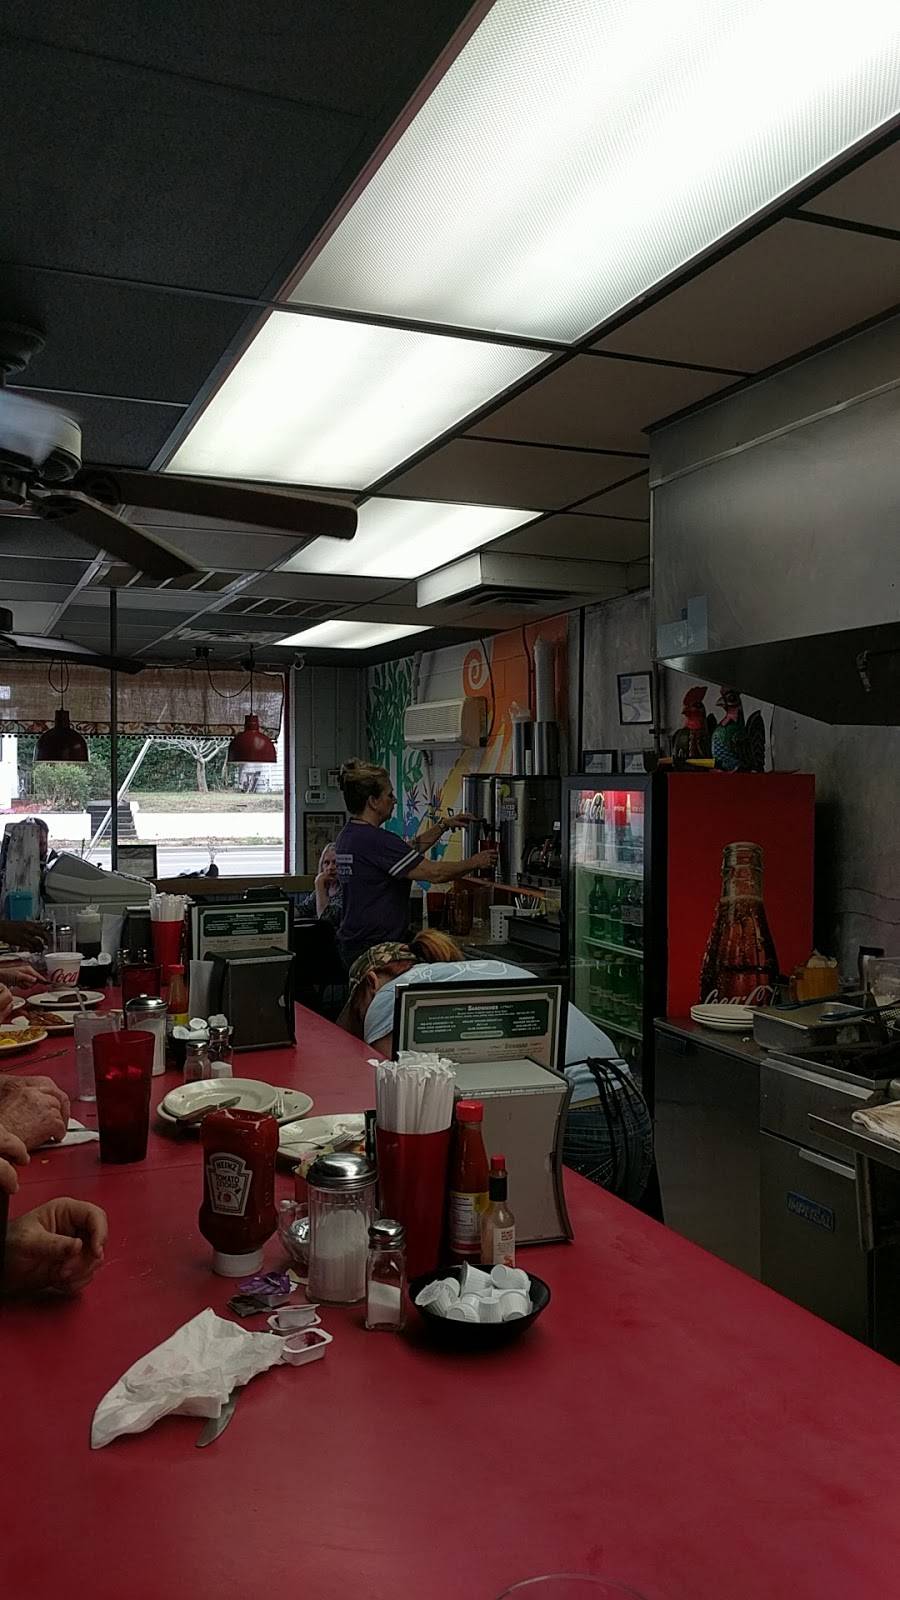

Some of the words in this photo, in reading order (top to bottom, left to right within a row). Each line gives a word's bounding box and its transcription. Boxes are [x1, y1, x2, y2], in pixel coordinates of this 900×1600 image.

[51, 968, 77, 985] Coca
[216, 1161, 237, 1171] HEINZ
[215, 1174, 241, 1184] TOMATO
